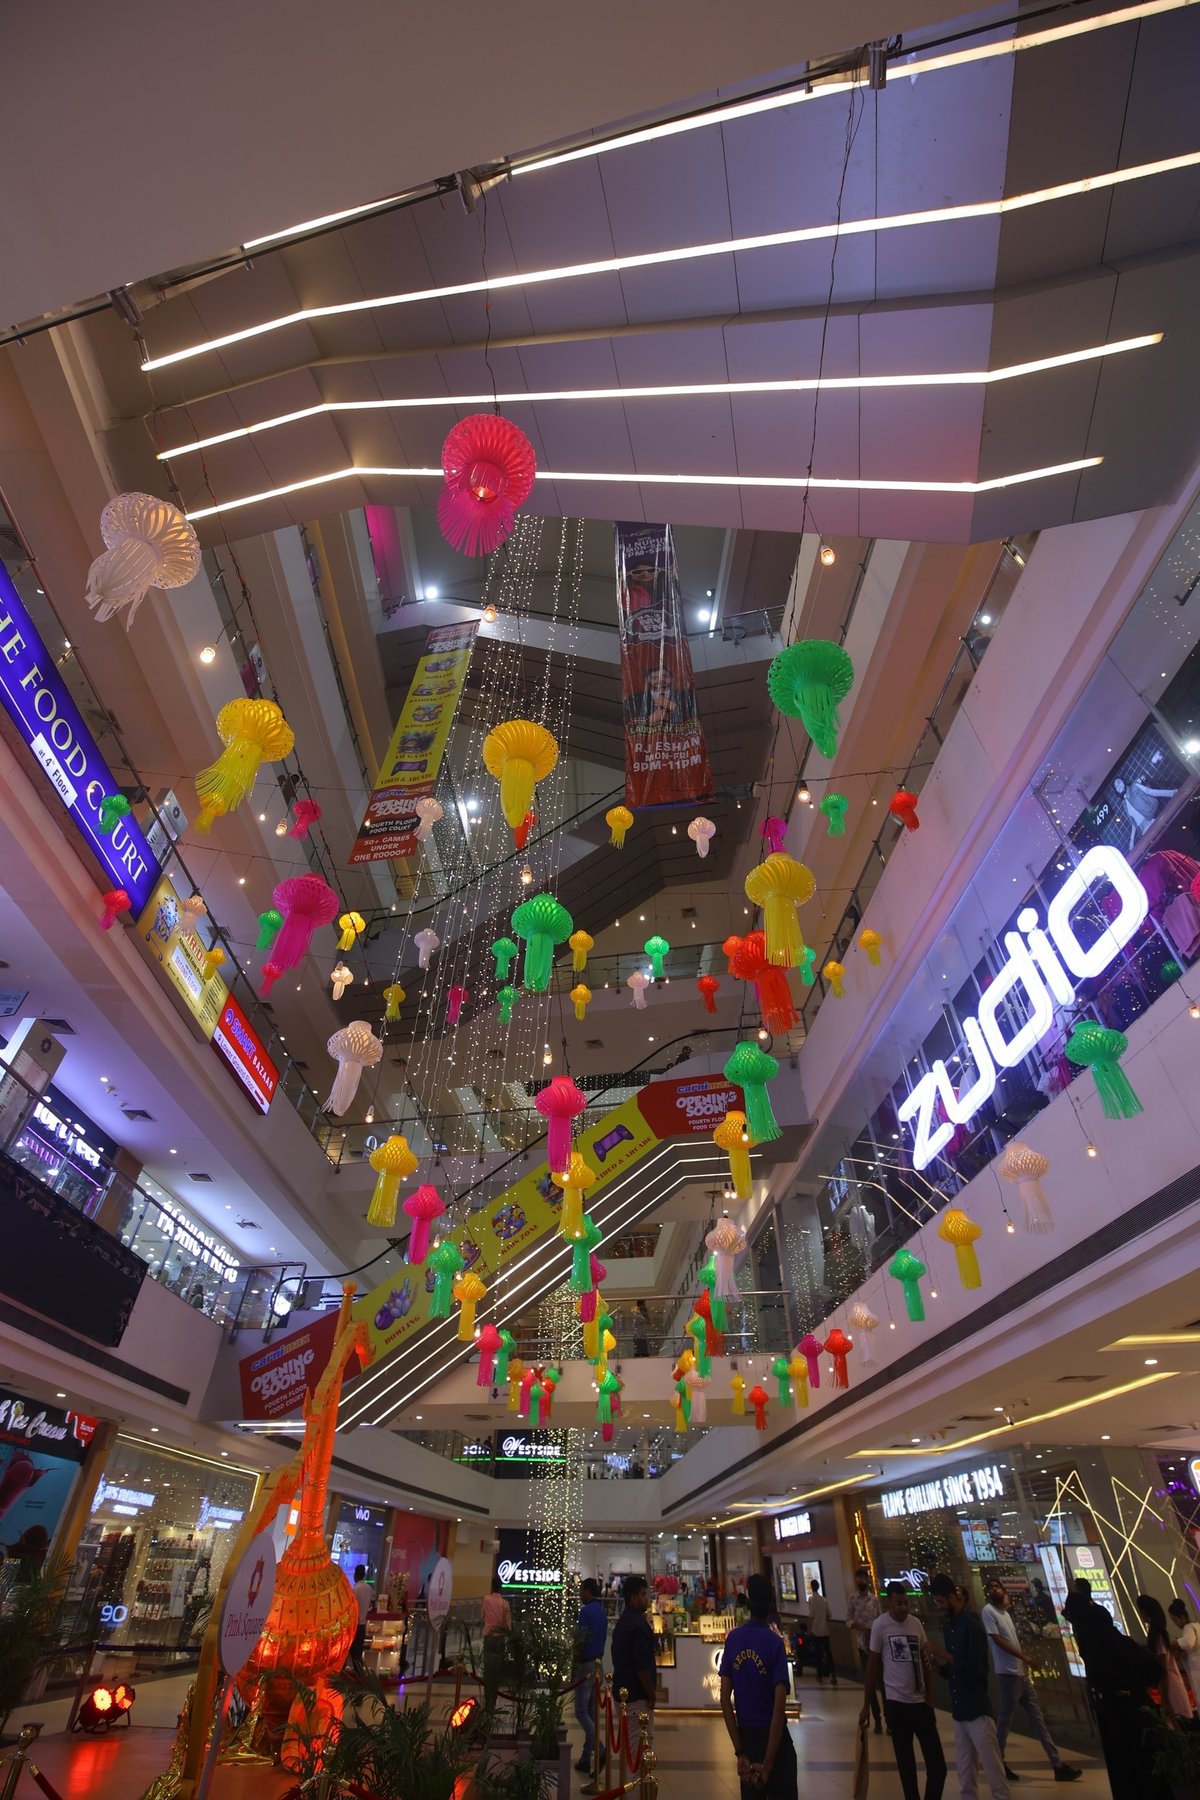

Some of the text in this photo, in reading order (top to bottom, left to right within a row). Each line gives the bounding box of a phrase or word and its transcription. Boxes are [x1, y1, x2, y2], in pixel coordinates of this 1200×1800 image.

[635, 736, 700, 754] RJ ESHAN
[633, 754, 701, 772] 9PM-11PM
[645, 751, 689, 762] MON-FRI
[19, 662, 88, 778] FOOD
[86, 780, 148, 884] CURT
[52, 767, 70, 796] Floor
[369, 826, 388, 835] FOOD
[394, 817, 418, 825] FLOOR
[370, 843, 399, 851] UNDER
[382, 834, 410, 842] GAMES
[354, 853, 371, 861] ONE
[220, 1039, 233, 1060] Lower
[232, 1056, 246, 1079] Ground
[231, 1018, 273, 1091] SMART BAZAAR
[676, 1091, 737, 1109] OPENING
[596, 1164, 618, 1182] VIDEO
[625, 1136, 652, 1159] ARCADE
[500, 1223, 539, 1256] KIDS ZONE
[384, 1315, 421, 1345] BOWLING
[251, 1349, 315, 1392] OPENING
[262, 1370, 305, 1400] SOON!
[264, 1383, 307, 1410] FOURTH FLOOR
[269, 1393, 304, 1415] FOOD COURT
[502, 1437, 561, 1457] WESTSIDE
[881, 1465, 1003, 1518] FLAME GRILLING SINCE 1954
[498, 1560, 561, 1583] WESTSIDE
[1074, 1569, 1105, 1579] TASTY
[1090, 1580, 1109, 1591] ALS
[101, 1605, 128, 1622] 90
[224, 1612, 265, 1640] Pink Square
[733, 1649, 767, 1675] SECURITY
